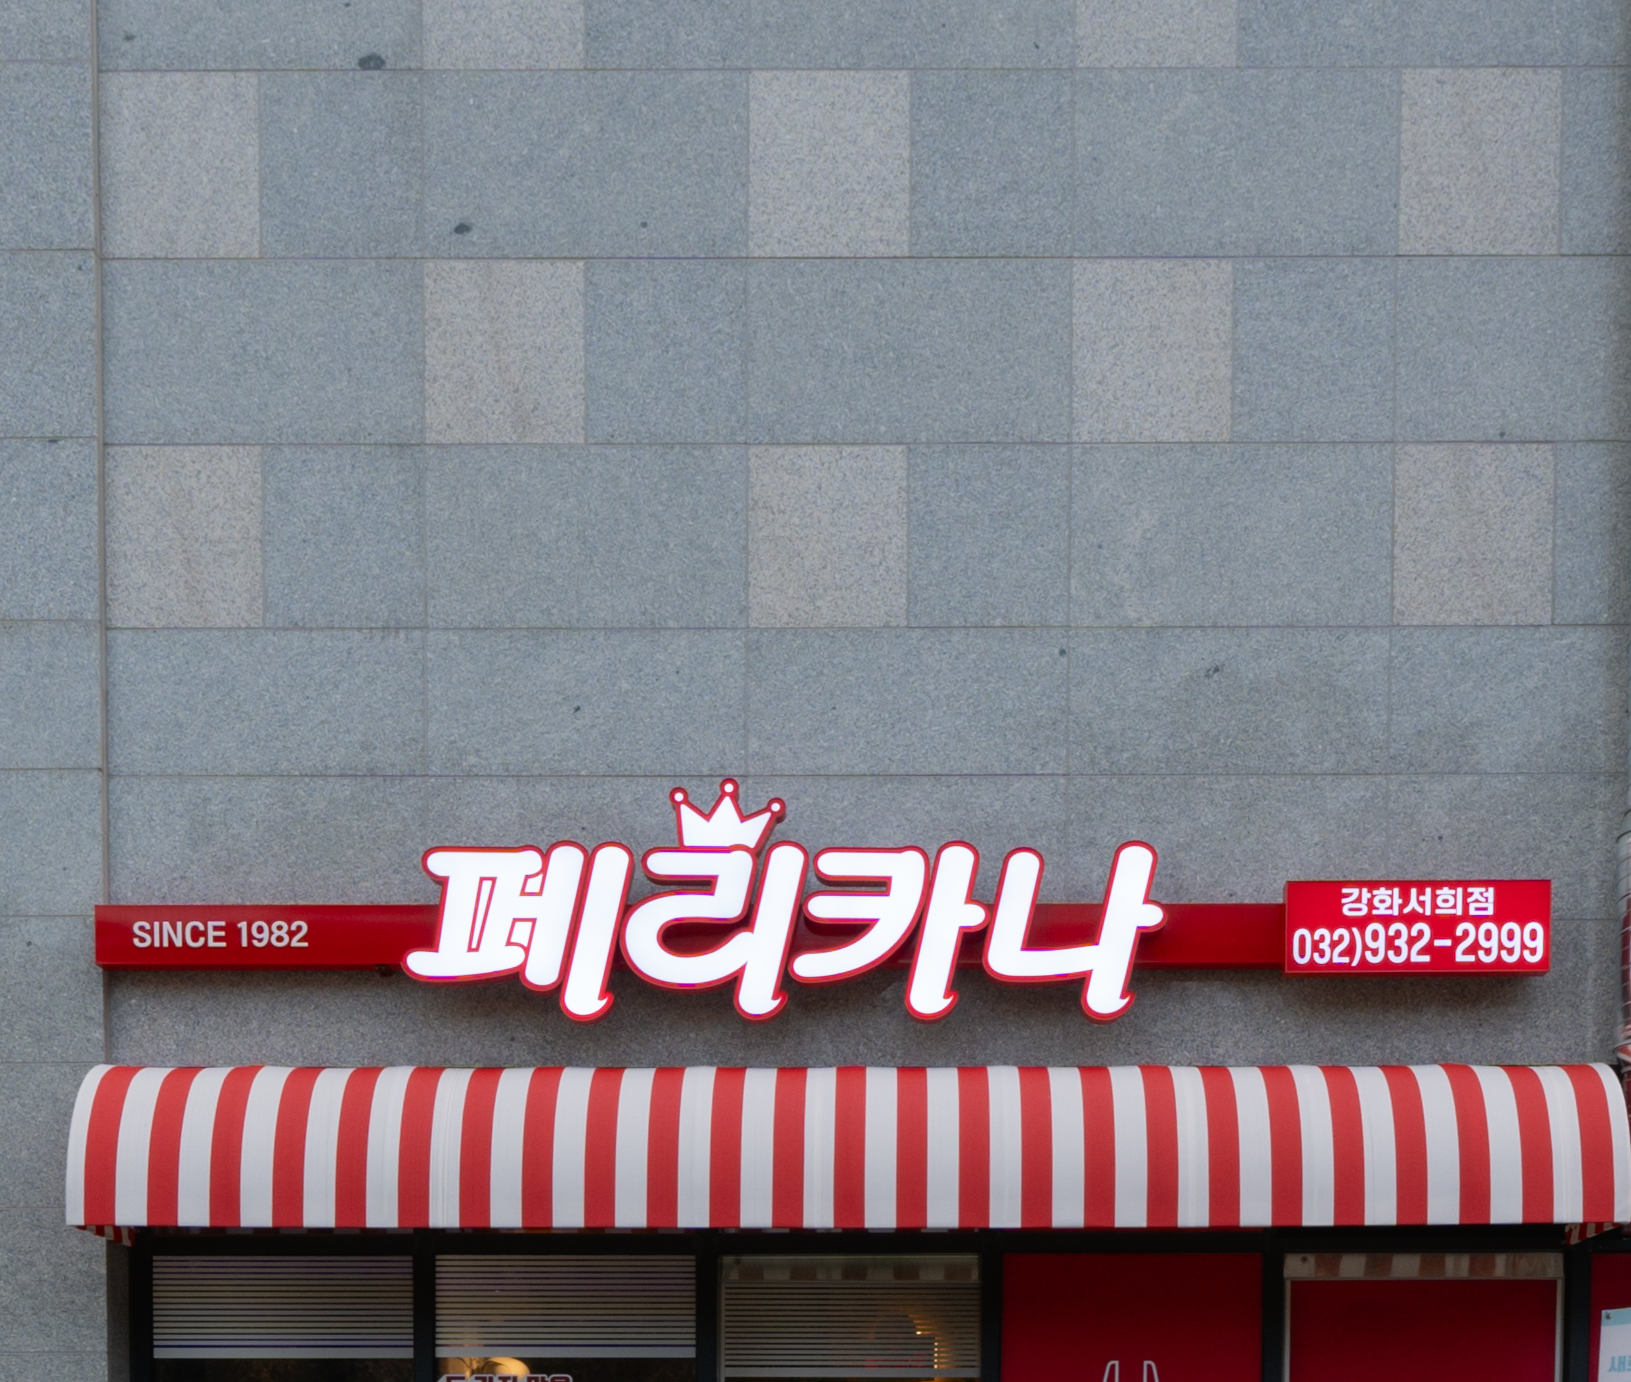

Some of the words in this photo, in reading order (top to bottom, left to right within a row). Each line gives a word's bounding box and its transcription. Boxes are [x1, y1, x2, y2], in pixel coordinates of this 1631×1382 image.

[1340, 886, 1495, 917] 강화서희점
[132, 921, 226, 948] SINCE
[237, 921, 308, 948] 1982
[403, 840, 1166, 1021] 페리카나
[1292, 922, 1545, 967] 032)932-2999
